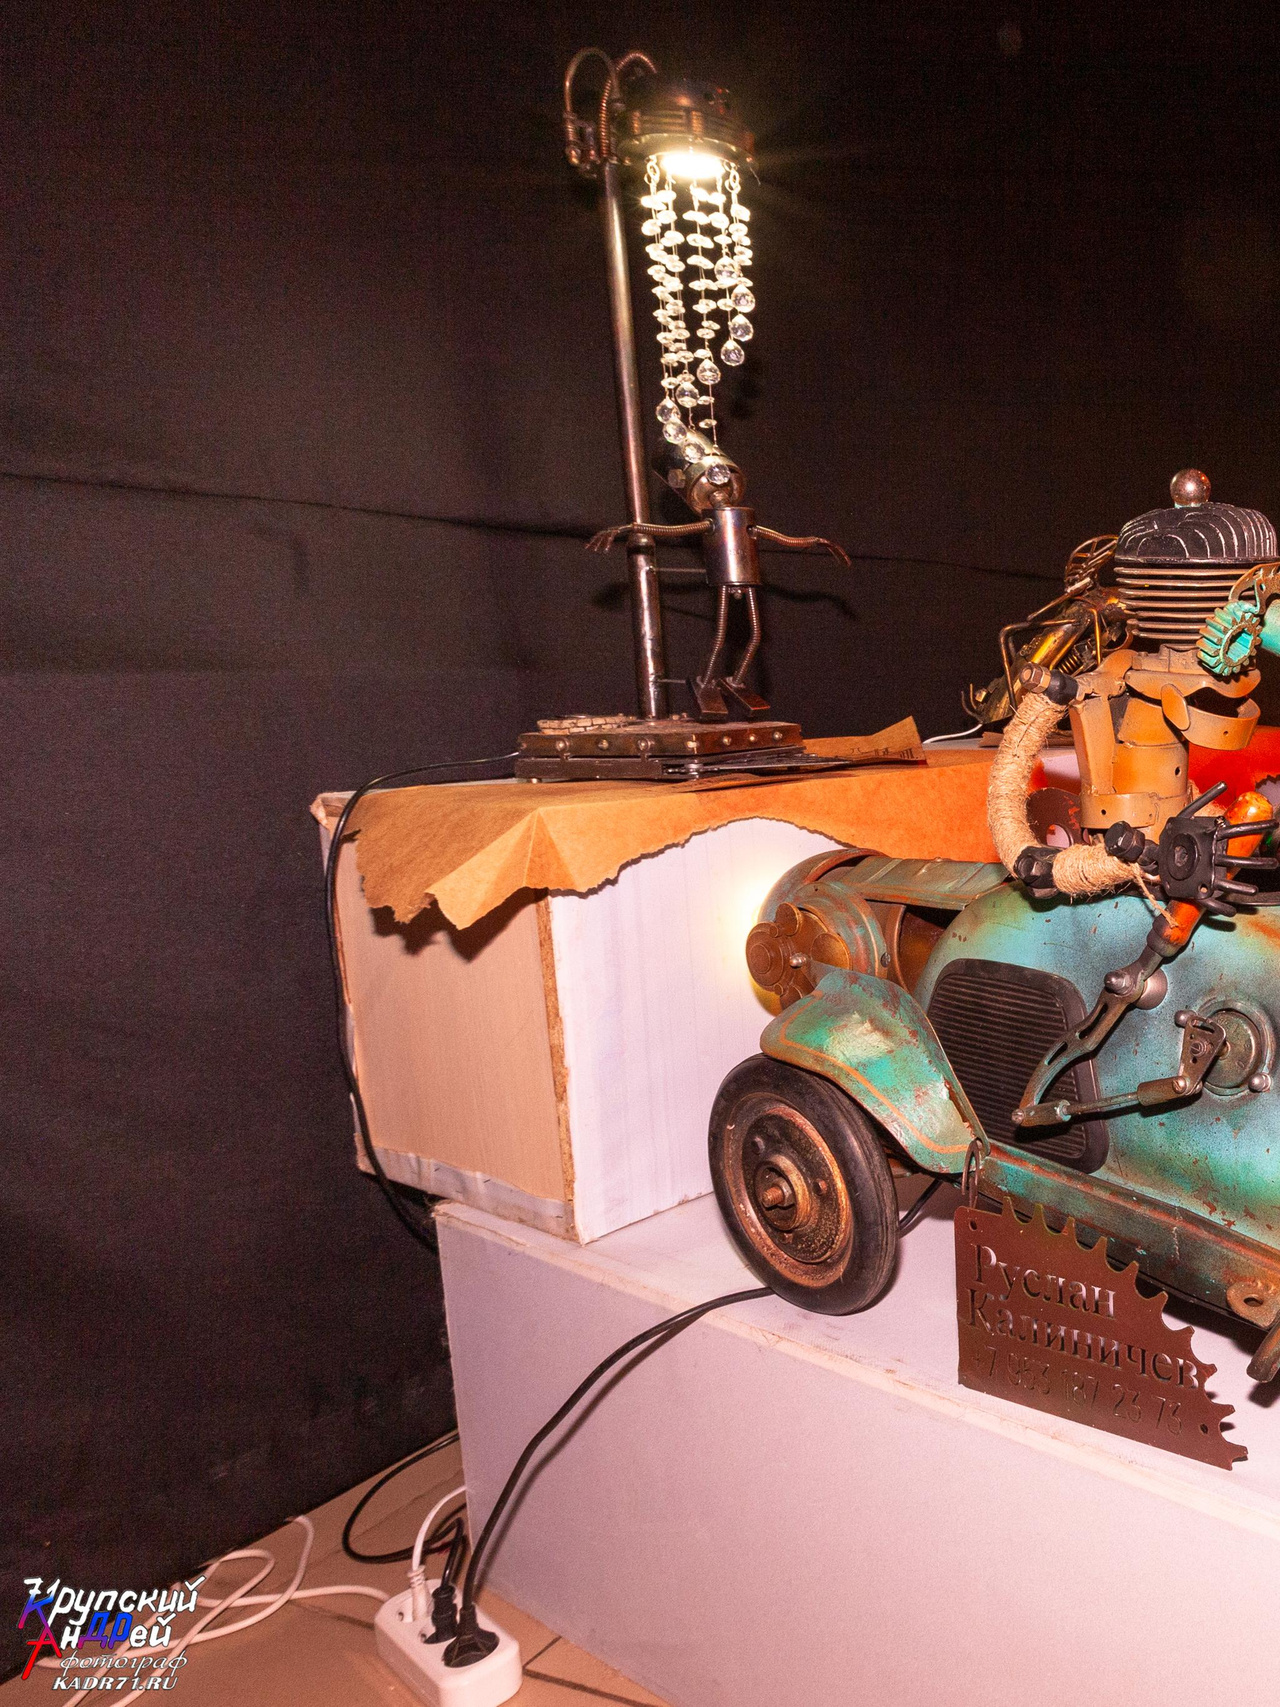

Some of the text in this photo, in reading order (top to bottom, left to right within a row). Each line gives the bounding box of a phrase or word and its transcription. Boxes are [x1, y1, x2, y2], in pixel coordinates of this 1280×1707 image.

[972, 1243, 1116, 1320] Руслан
[967, 1288, 1199, 1389] Калиничев
[1112, 1383, 1142, 1423] 23
[1151, 1396, 1182, 1435] 73
